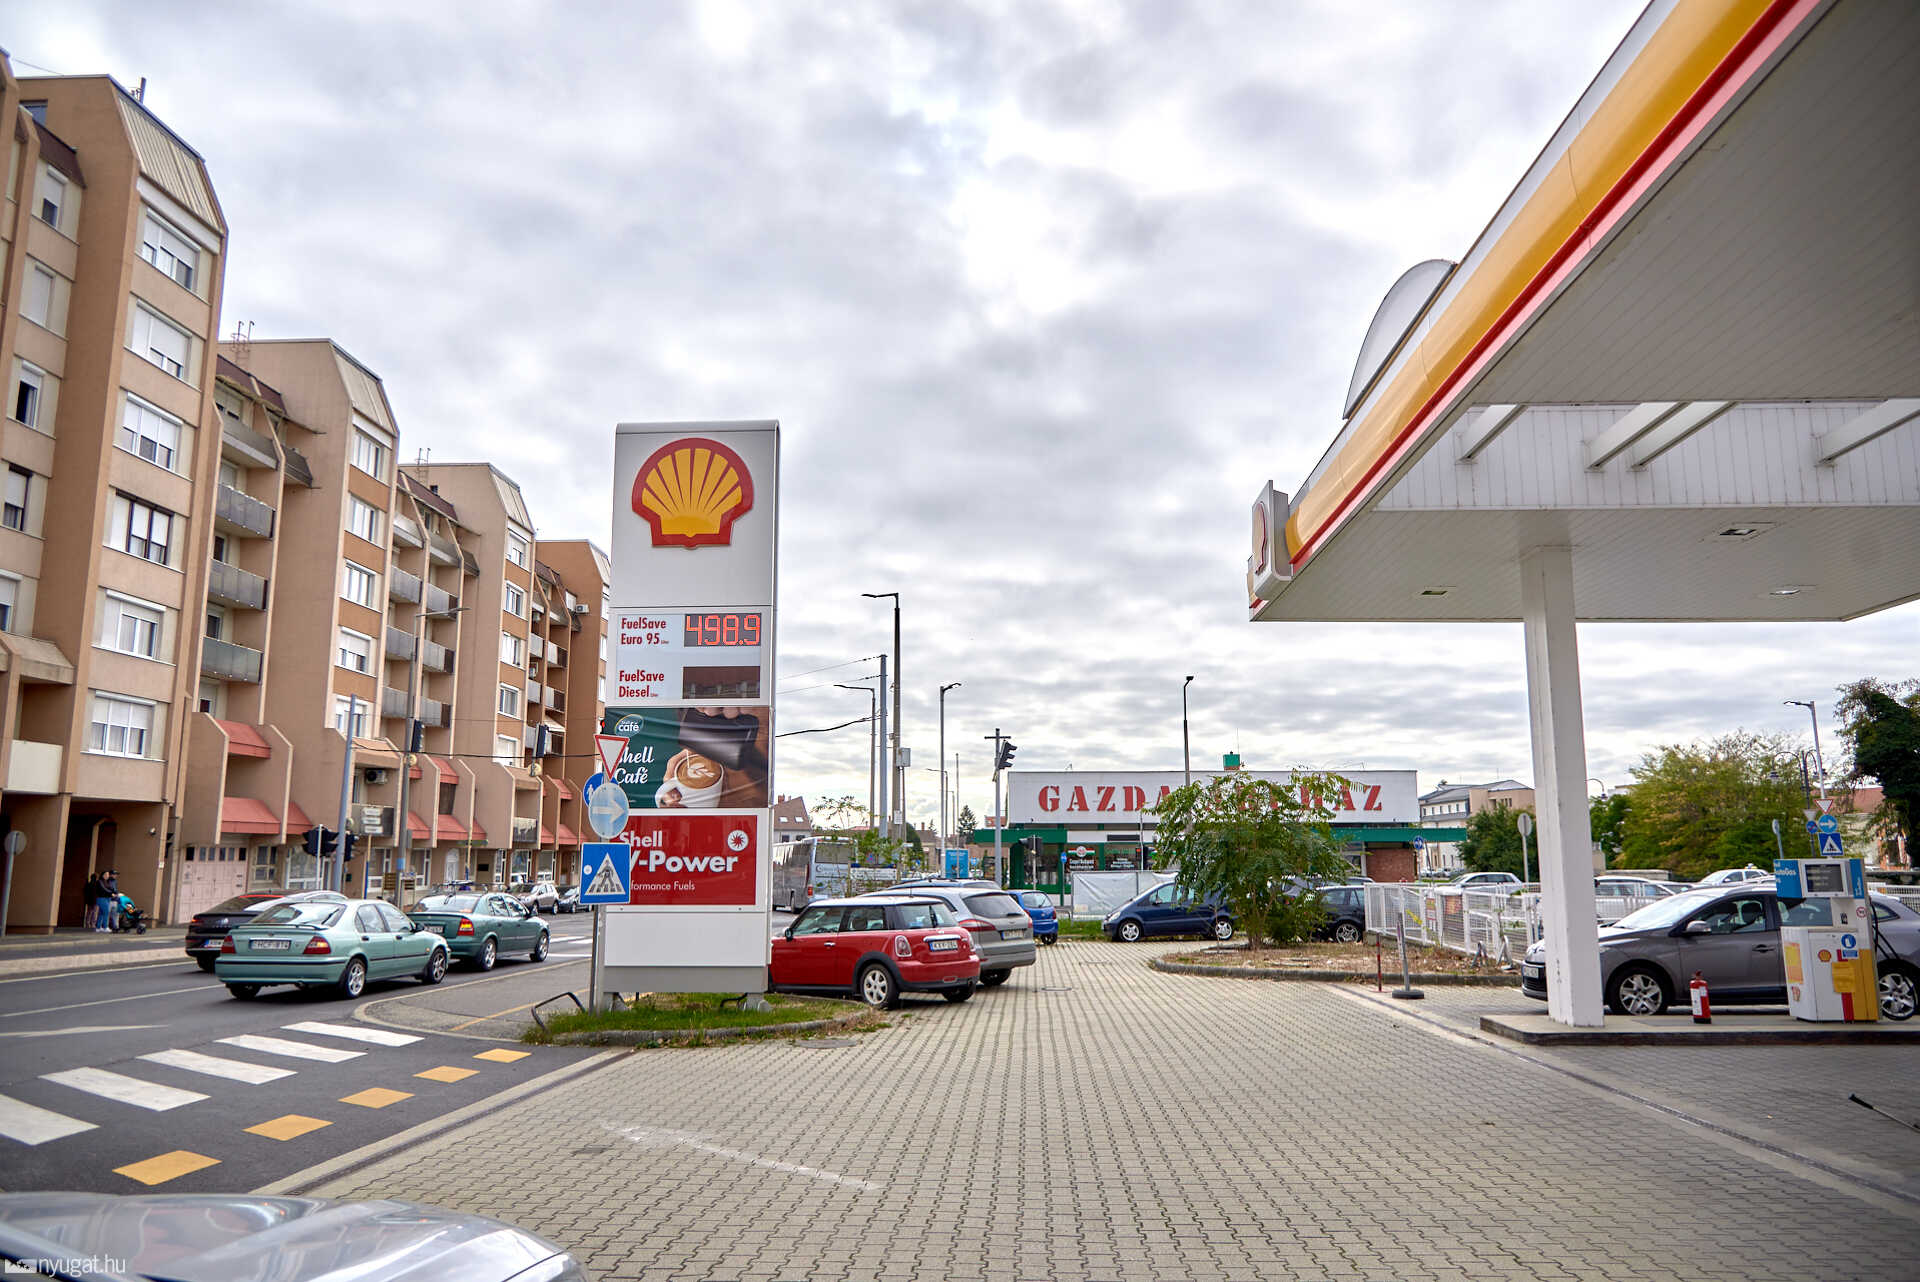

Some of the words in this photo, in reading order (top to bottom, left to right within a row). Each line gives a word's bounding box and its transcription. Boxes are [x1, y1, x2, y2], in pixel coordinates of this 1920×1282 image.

[621, 617, 667, 629] FuelSave
[686, 615, 760, 646] 498.9
[621, 633, 642, 645] Euro
[646, 633, 660, 645] 95
[619, 669, 665, 682] FuelSave
[618, 685, 649, 697] Diesel
[618, 722, 640, 732] café
[619, 746, 655, 764] hell
[615, 767, 648, 784] Café
[619, 831, 663, 847] Shell
[631, 880, 671, 891] formance
[674, 880, 696, 891] Fuels
